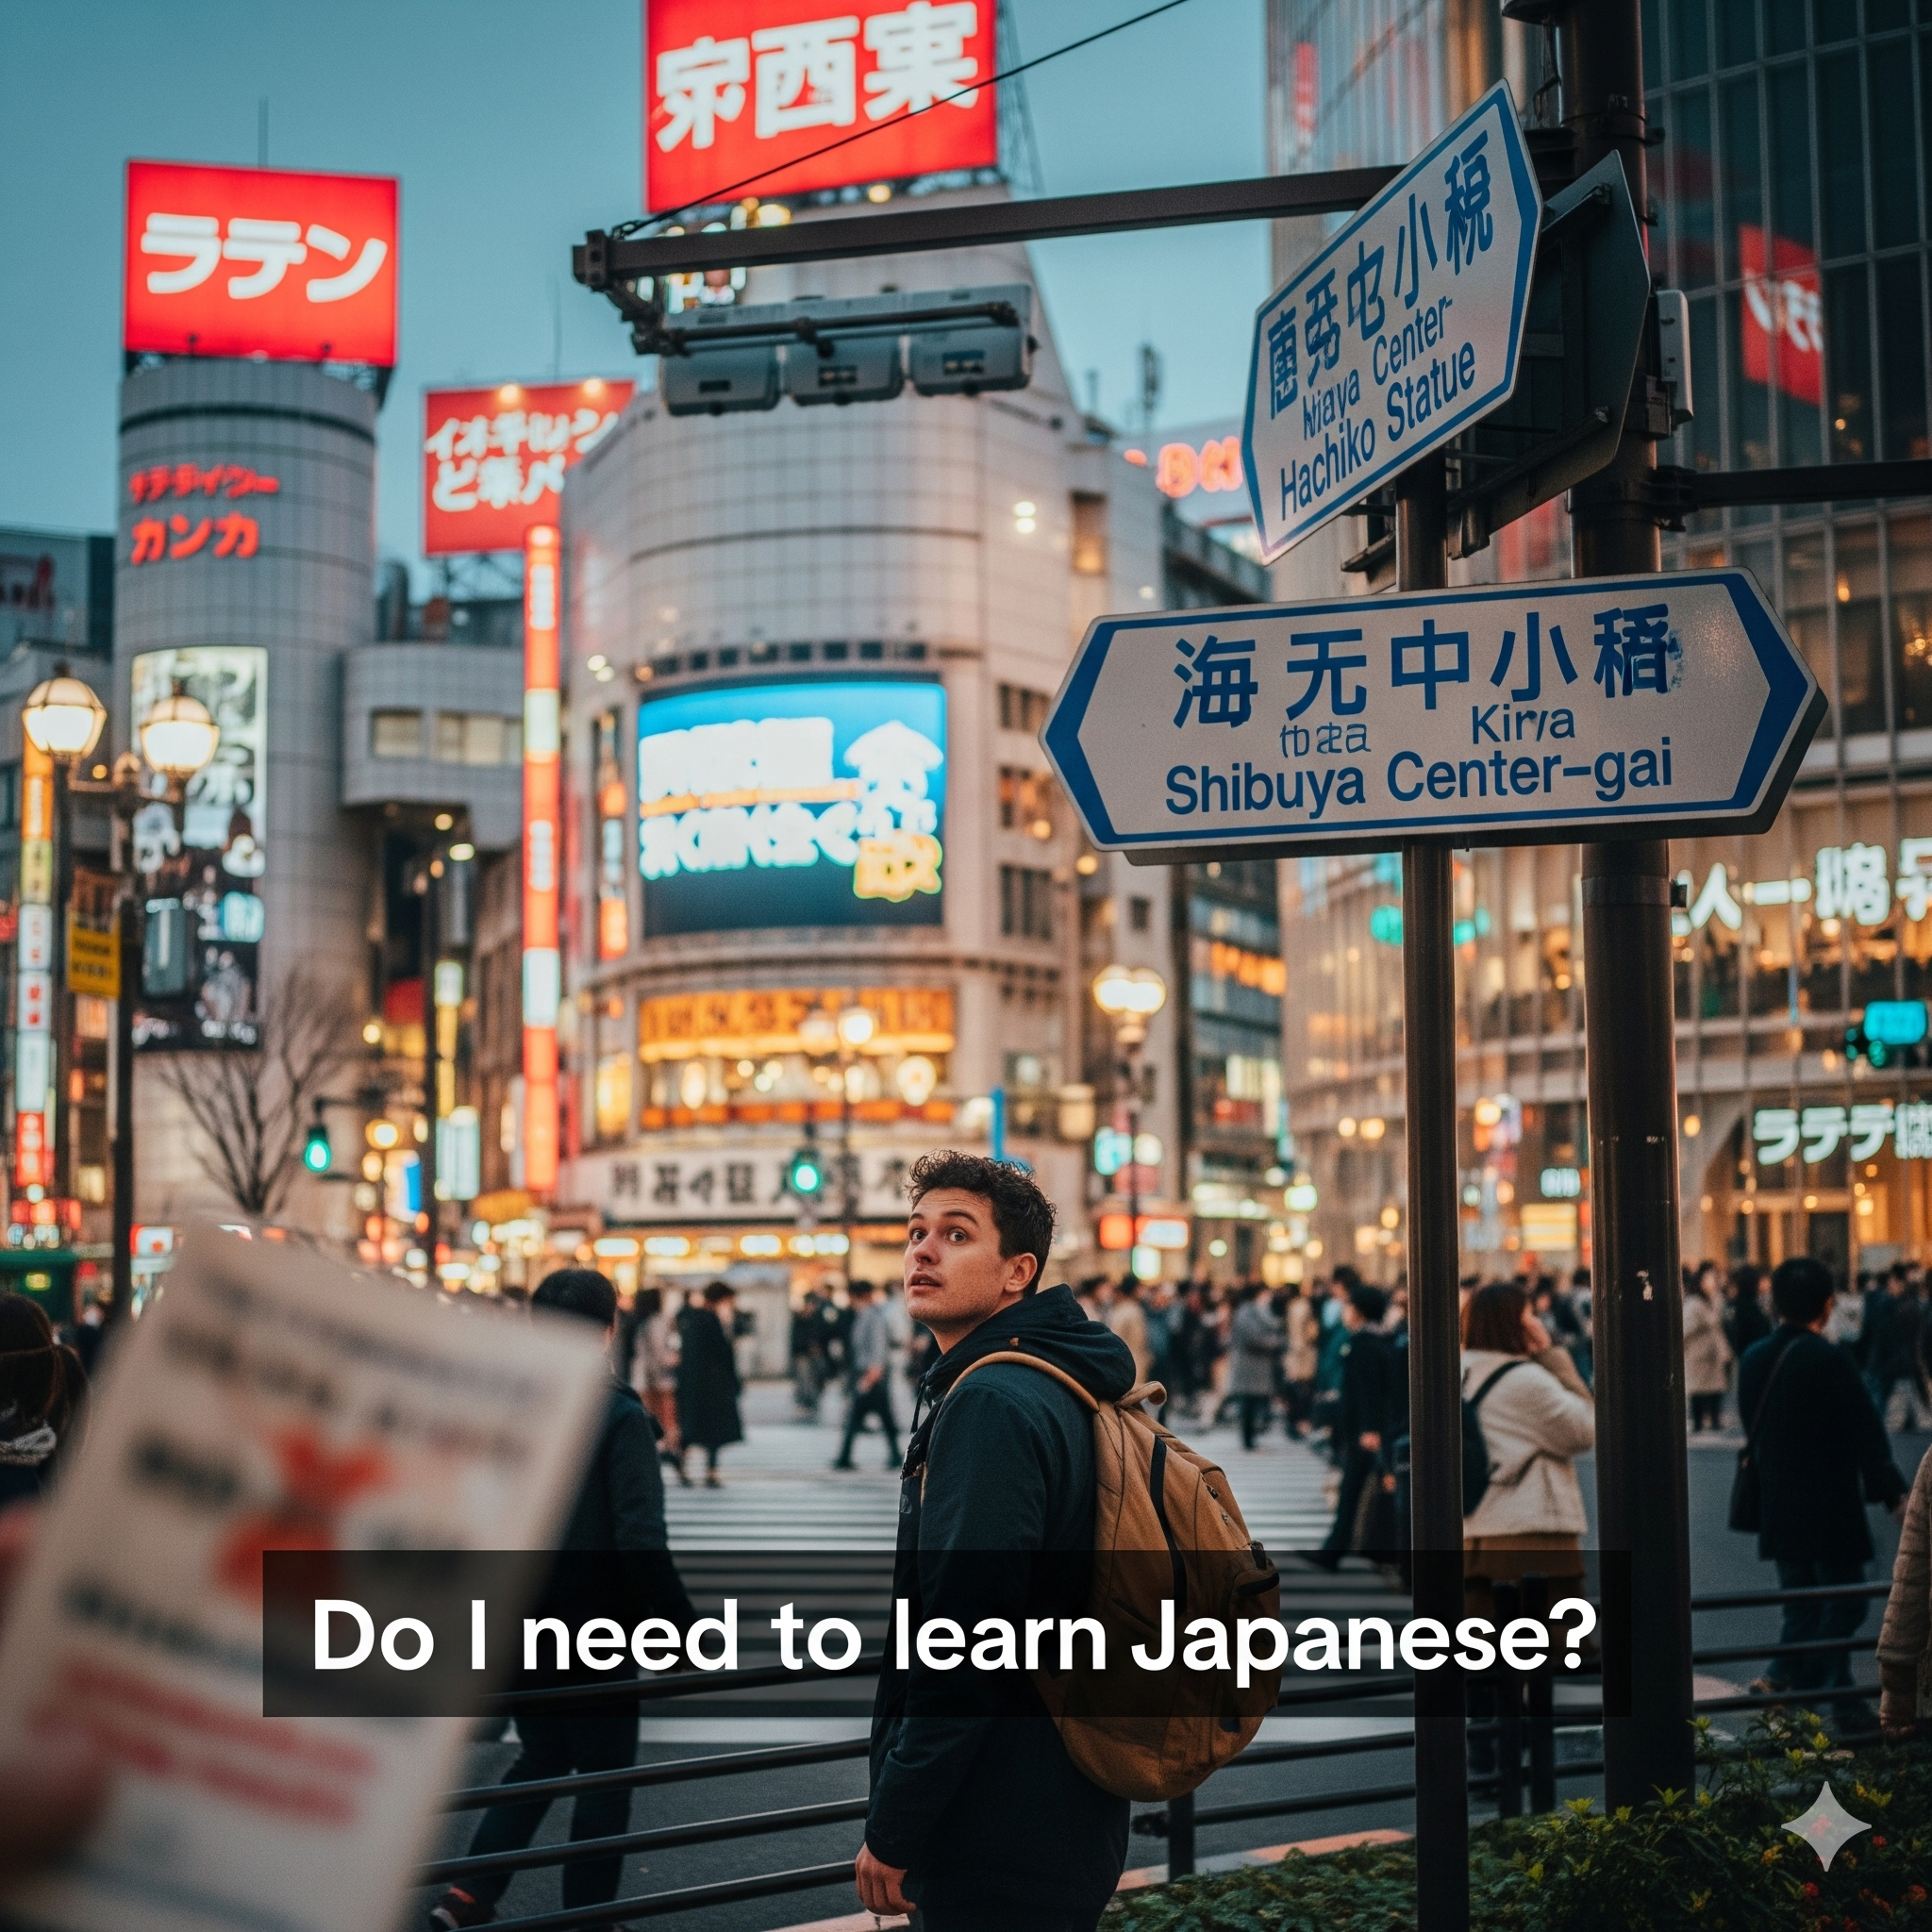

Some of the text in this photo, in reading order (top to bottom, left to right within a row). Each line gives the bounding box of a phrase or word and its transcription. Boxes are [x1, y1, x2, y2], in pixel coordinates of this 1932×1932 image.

[141, 212, 388, 303] ラテン
[1374, 295, 1453, 386] Center-
[1280, 418, 1375, 521] Hachiko
[1387, 341, 1475, 441] Statue
[131, 511, 259, 565] カンカ
[1165, 761, 1367, 820] Shibuya
[1387, 736, 1673, 802] Center-gai
